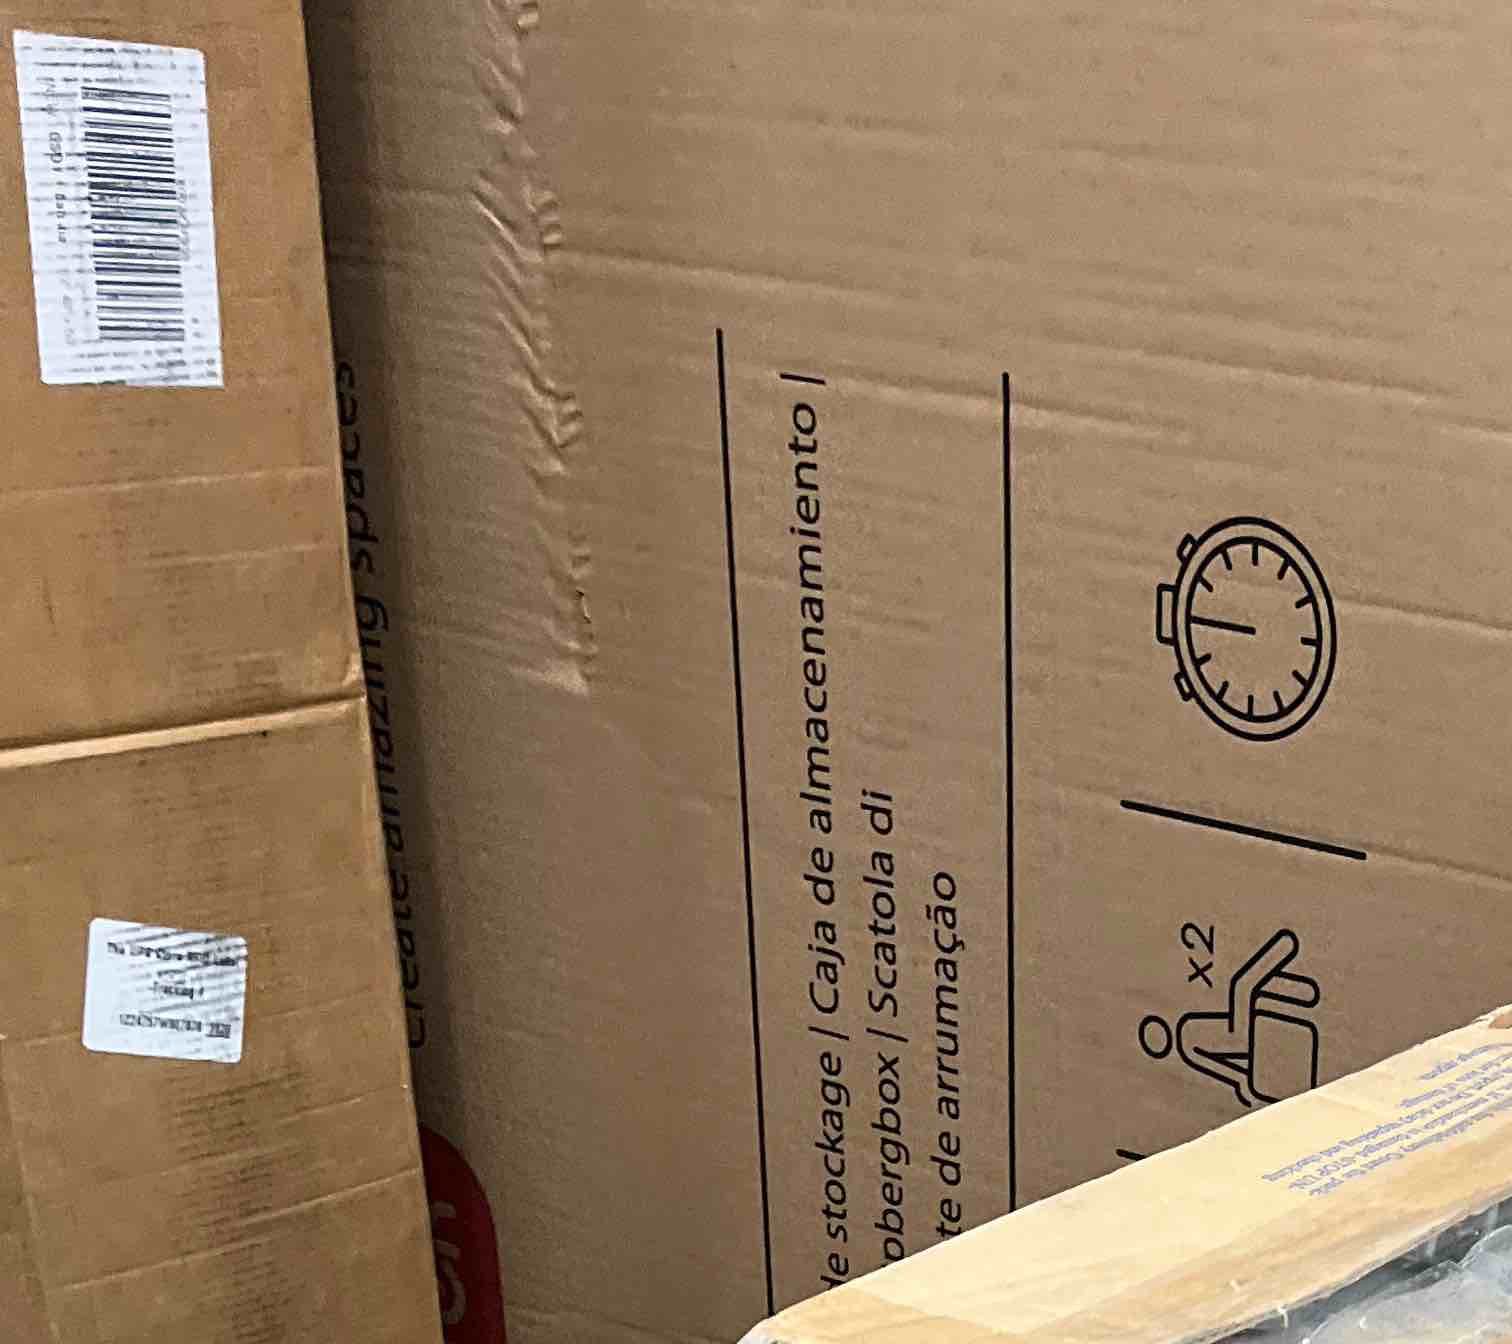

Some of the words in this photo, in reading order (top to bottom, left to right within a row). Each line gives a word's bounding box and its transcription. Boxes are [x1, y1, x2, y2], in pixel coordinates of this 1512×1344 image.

[788, 402, 832, 834] almacenamiento
[803, 847, 834, 906] de
[861, 788, 893, 836] di
[809, 919, 845, 1014] Caja
[864, 852, 899, 1017] Scatola
[926, 872, 965, 1120] arrumação
[1181, 922, 1214, 988] x2
[816, 1051, 851, 1243] stockage
[871, 1052, 910, 1268] pbergbox
[929, 1132, 960, 1186] de
